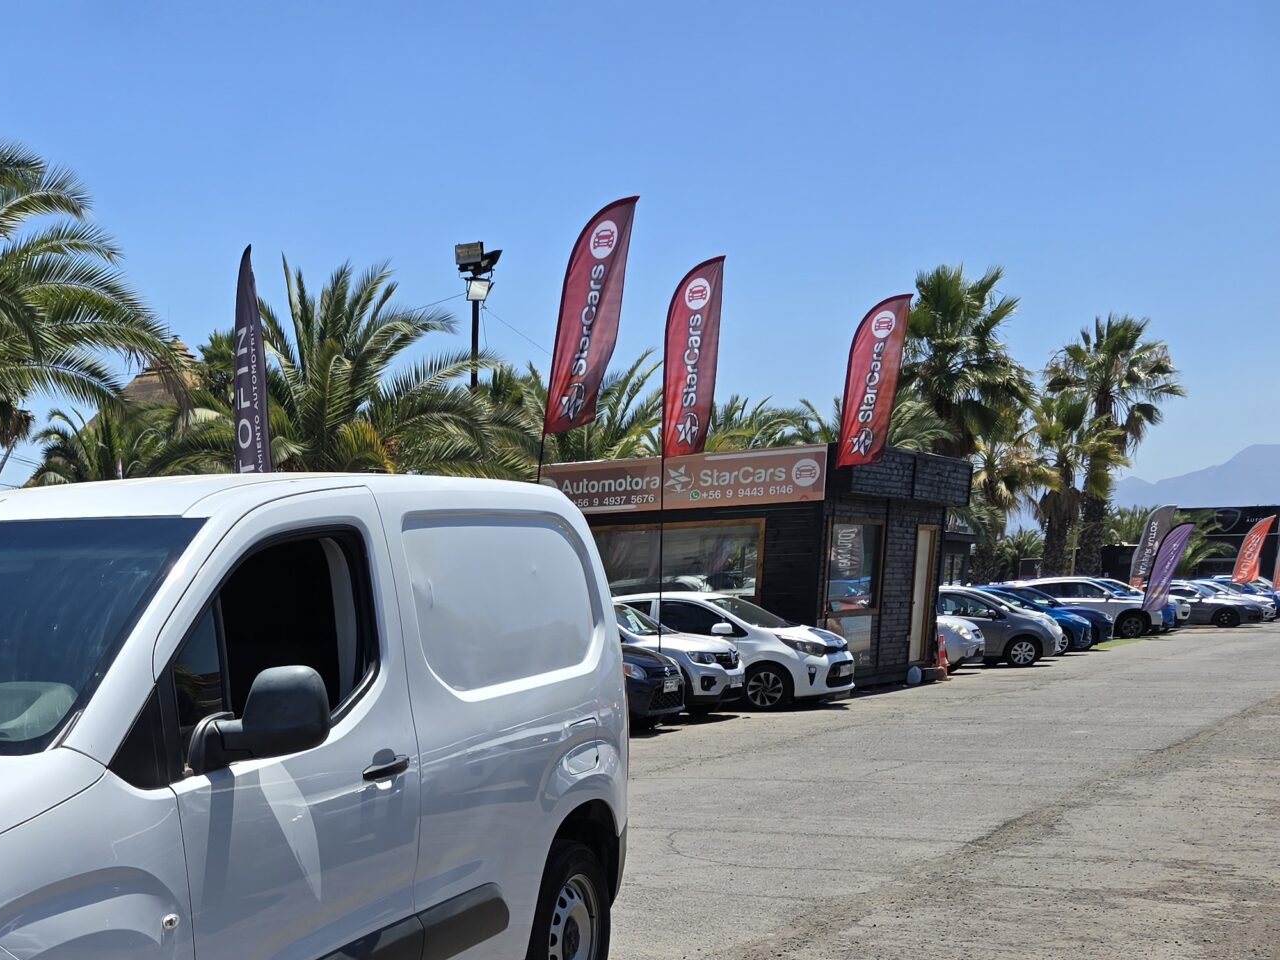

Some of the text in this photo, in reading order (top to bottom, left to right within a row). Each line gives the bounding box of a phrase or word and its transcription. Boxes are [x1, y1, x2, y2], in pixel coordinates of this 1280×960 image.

[572, 264, 605, 376] StarCars
[683, 313, 703, 407] StarCars
[858, 342, 885, 423] StarCars
[562, 475, 660, 495] Automotora
[699, 466, 786, 486] StarCars
[593, 498, 600, 506] 9
[603, 496, 626, 505] 4937
[631, 494, 655, 503] 5676
[702, 484, 793, 499] +56 9 9443 6146
